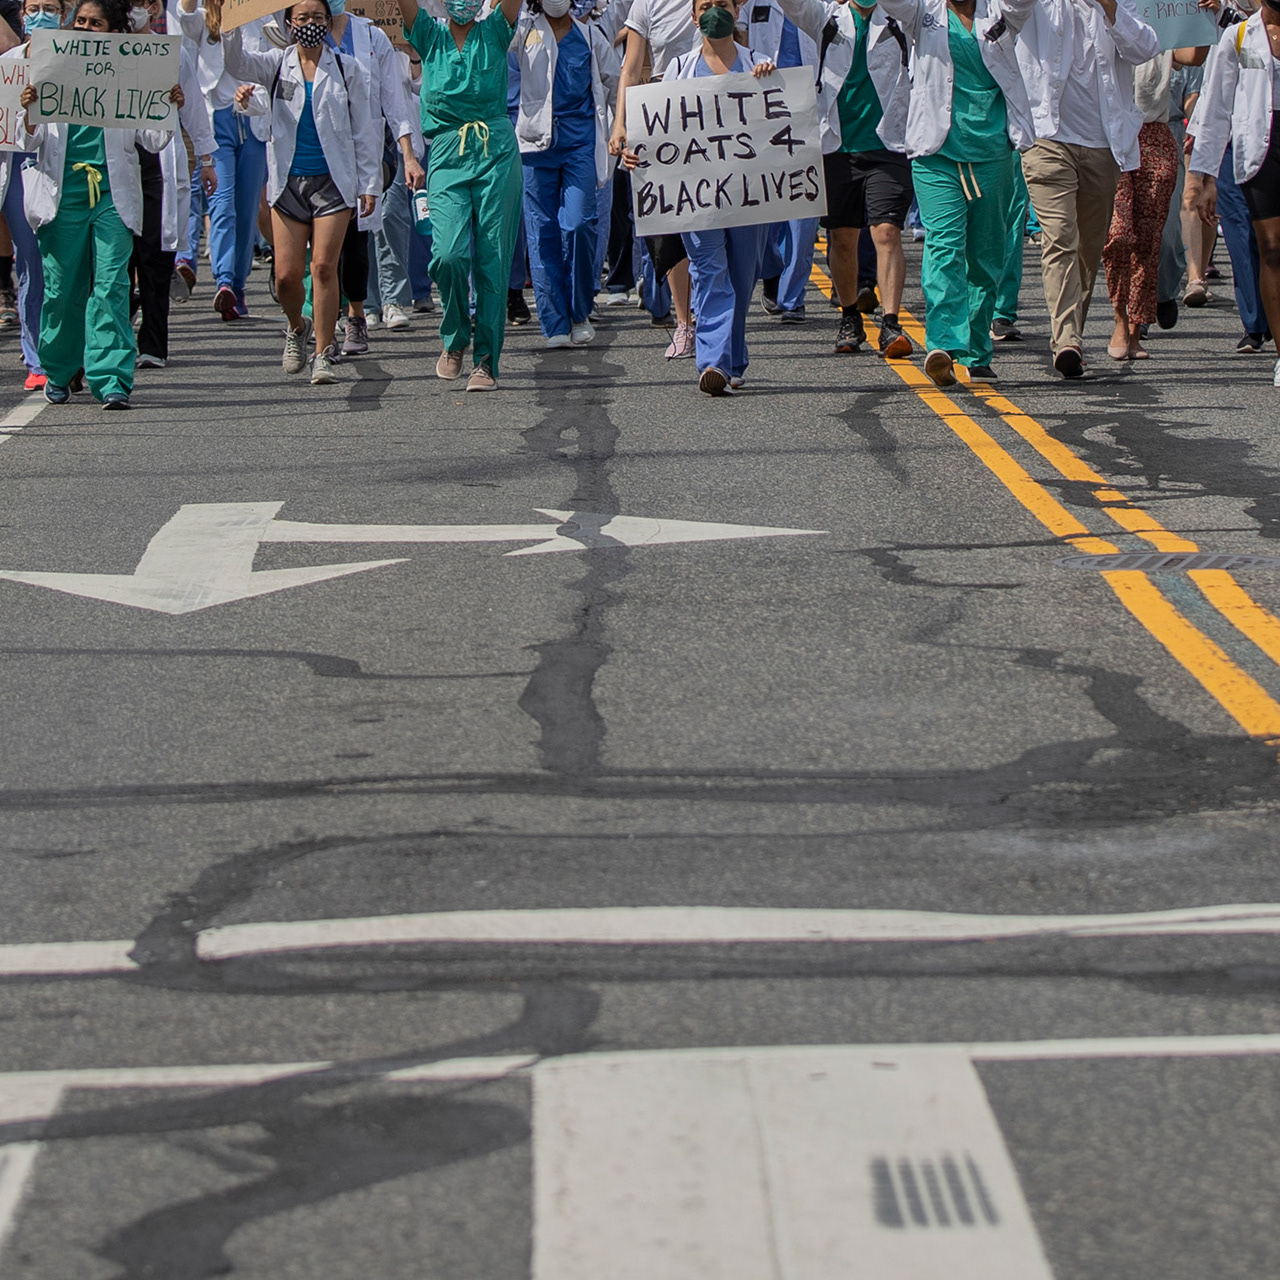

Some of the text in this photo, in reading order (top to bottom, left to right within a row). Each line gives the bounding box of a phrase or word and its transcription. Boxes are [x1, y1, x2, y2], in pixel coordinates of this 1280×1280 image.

[352, 8, 365, 16] IN
[53, 39, 170, 56] WHITE COATS
[86, 62, 115, 77] FOR
[40, 82, 171, 120] BLACK LIVES
[641, 88, 791, 136] WHITE
[633, 124, 805, 169] COATS 4
[637, 165, 819, 218] BLACK LIVES
